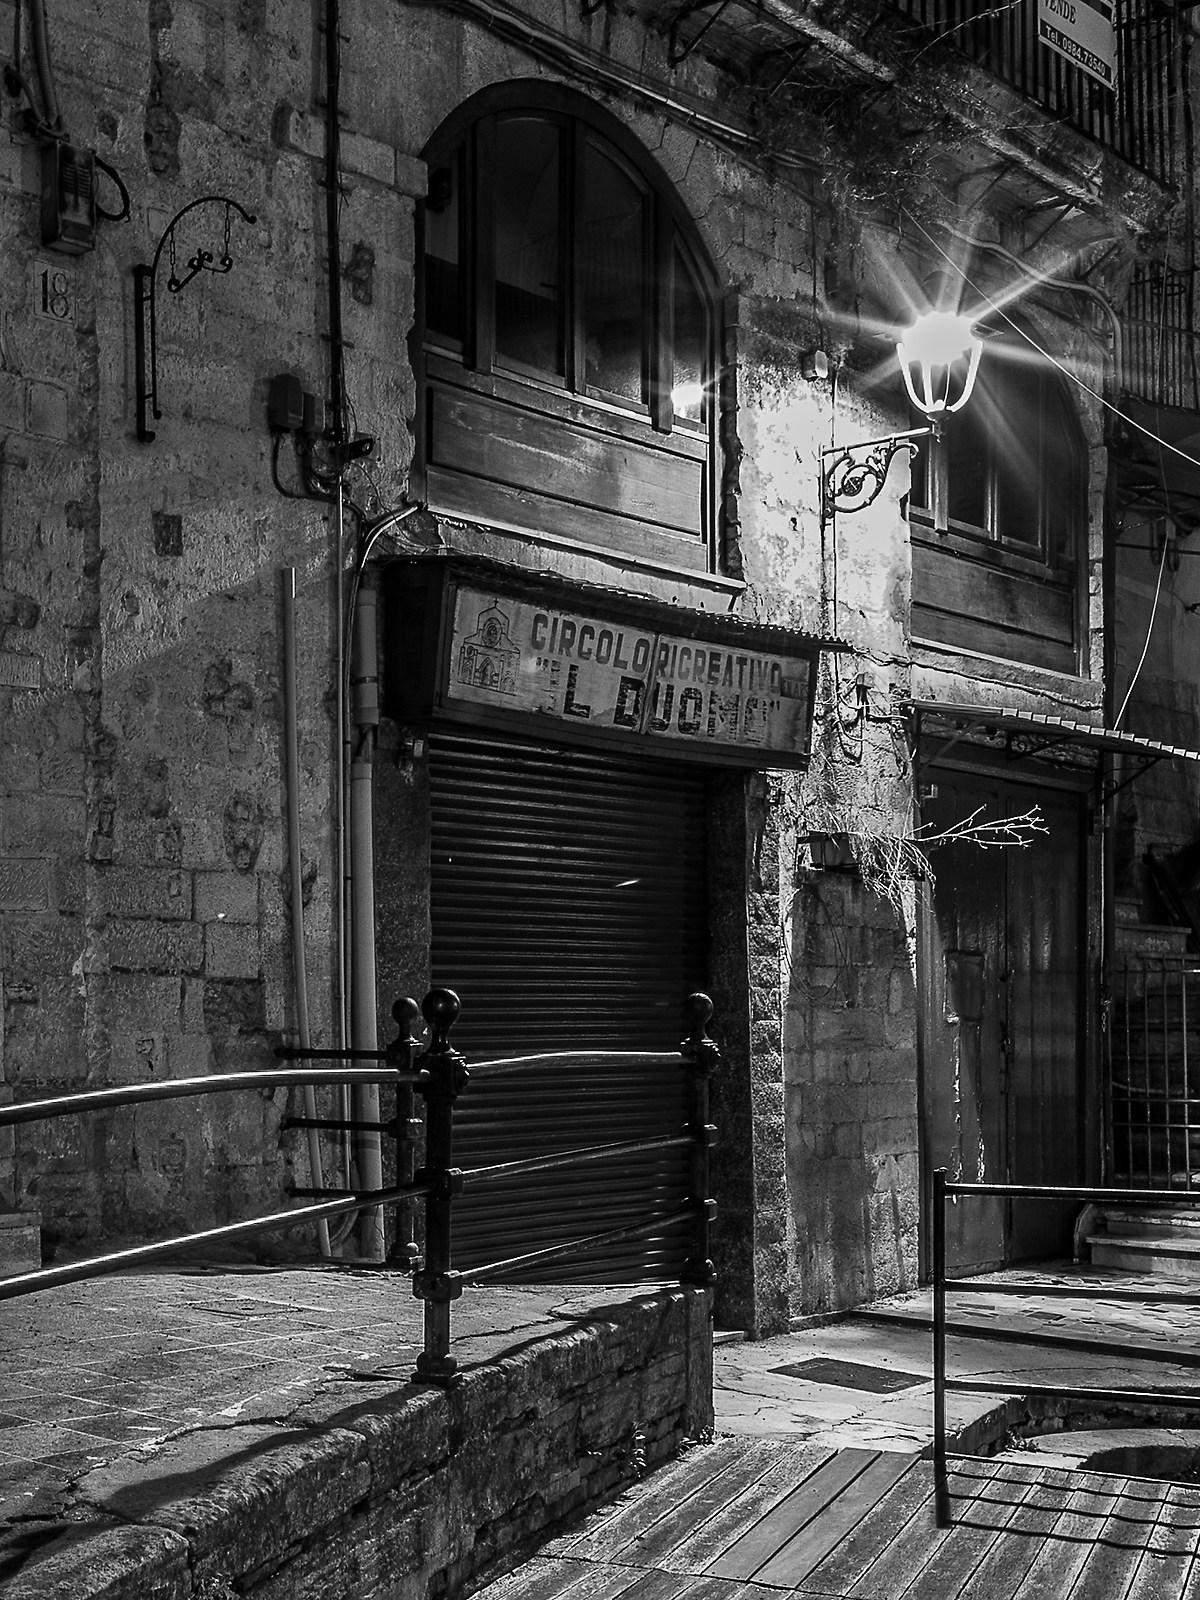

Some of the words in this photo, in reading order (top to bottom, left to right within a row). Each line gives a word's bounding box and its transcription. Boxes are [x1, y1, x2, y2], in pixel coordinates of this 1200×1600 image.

[1046, 25, 1060, 45] Tel.
[40, 269, 70, 318] 18
[531, 613, 651, 673] CIRCOLO
[655, 642, 782, 694] RICREATIVO
